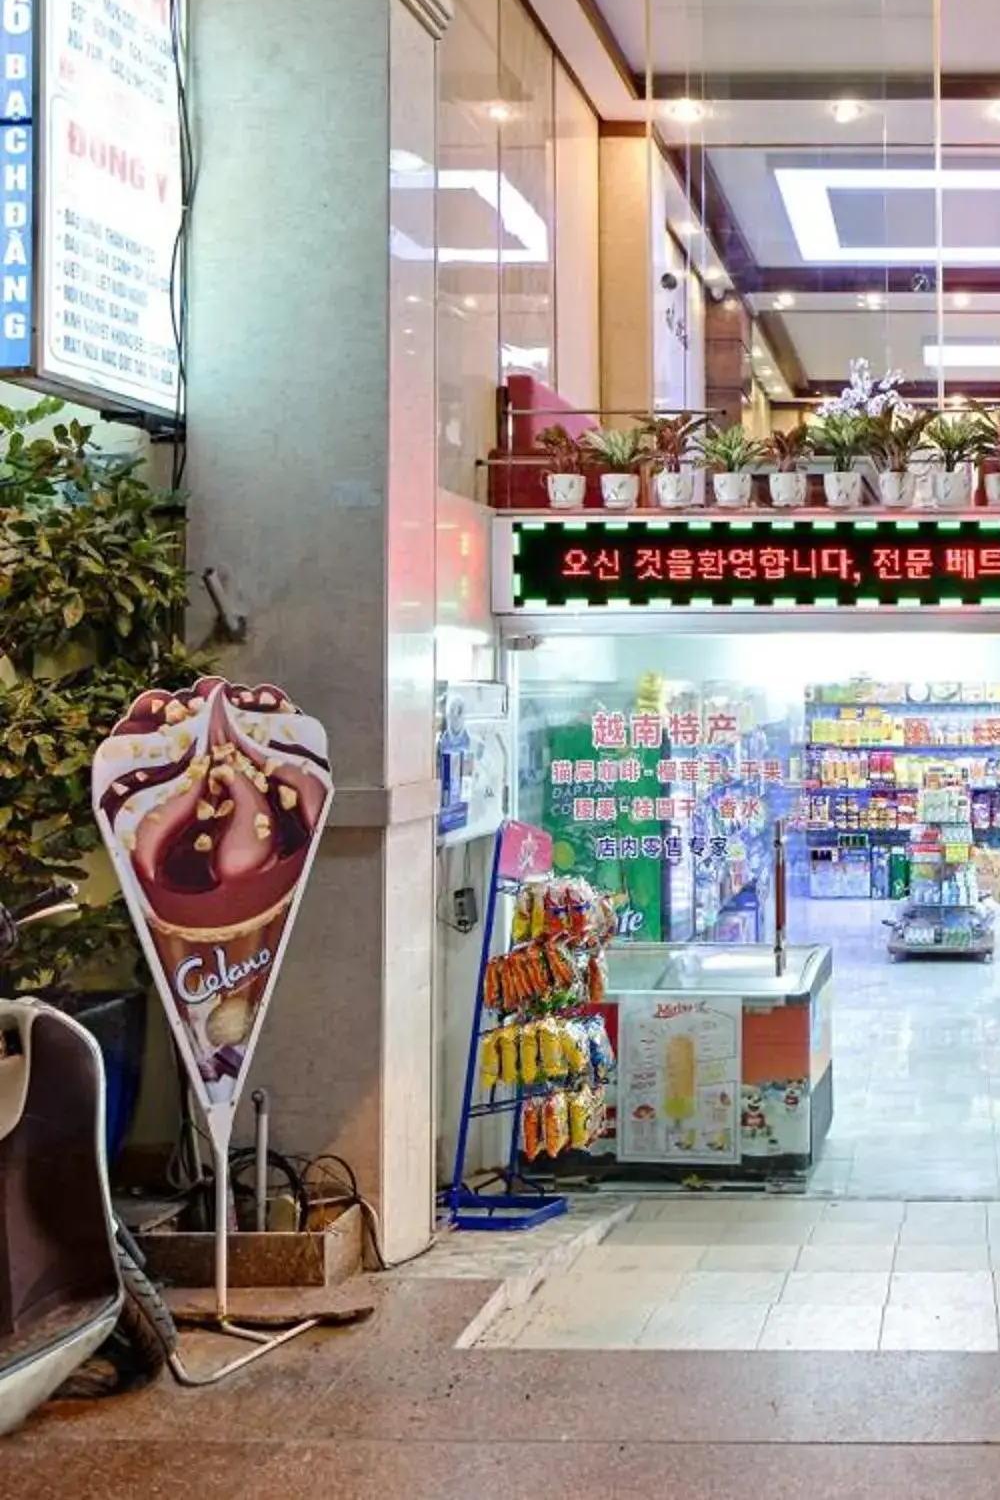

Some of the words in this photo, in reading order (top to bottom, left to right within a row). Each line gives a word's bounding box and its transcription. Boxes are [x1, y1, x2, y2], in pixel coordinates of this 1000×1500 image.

[562, 548, 621, 580] 오신
[873, 548, 933, 580] 전문
[593, 712, 738, 748] 越南特产
[176, 945, 271, 1004] Celano
